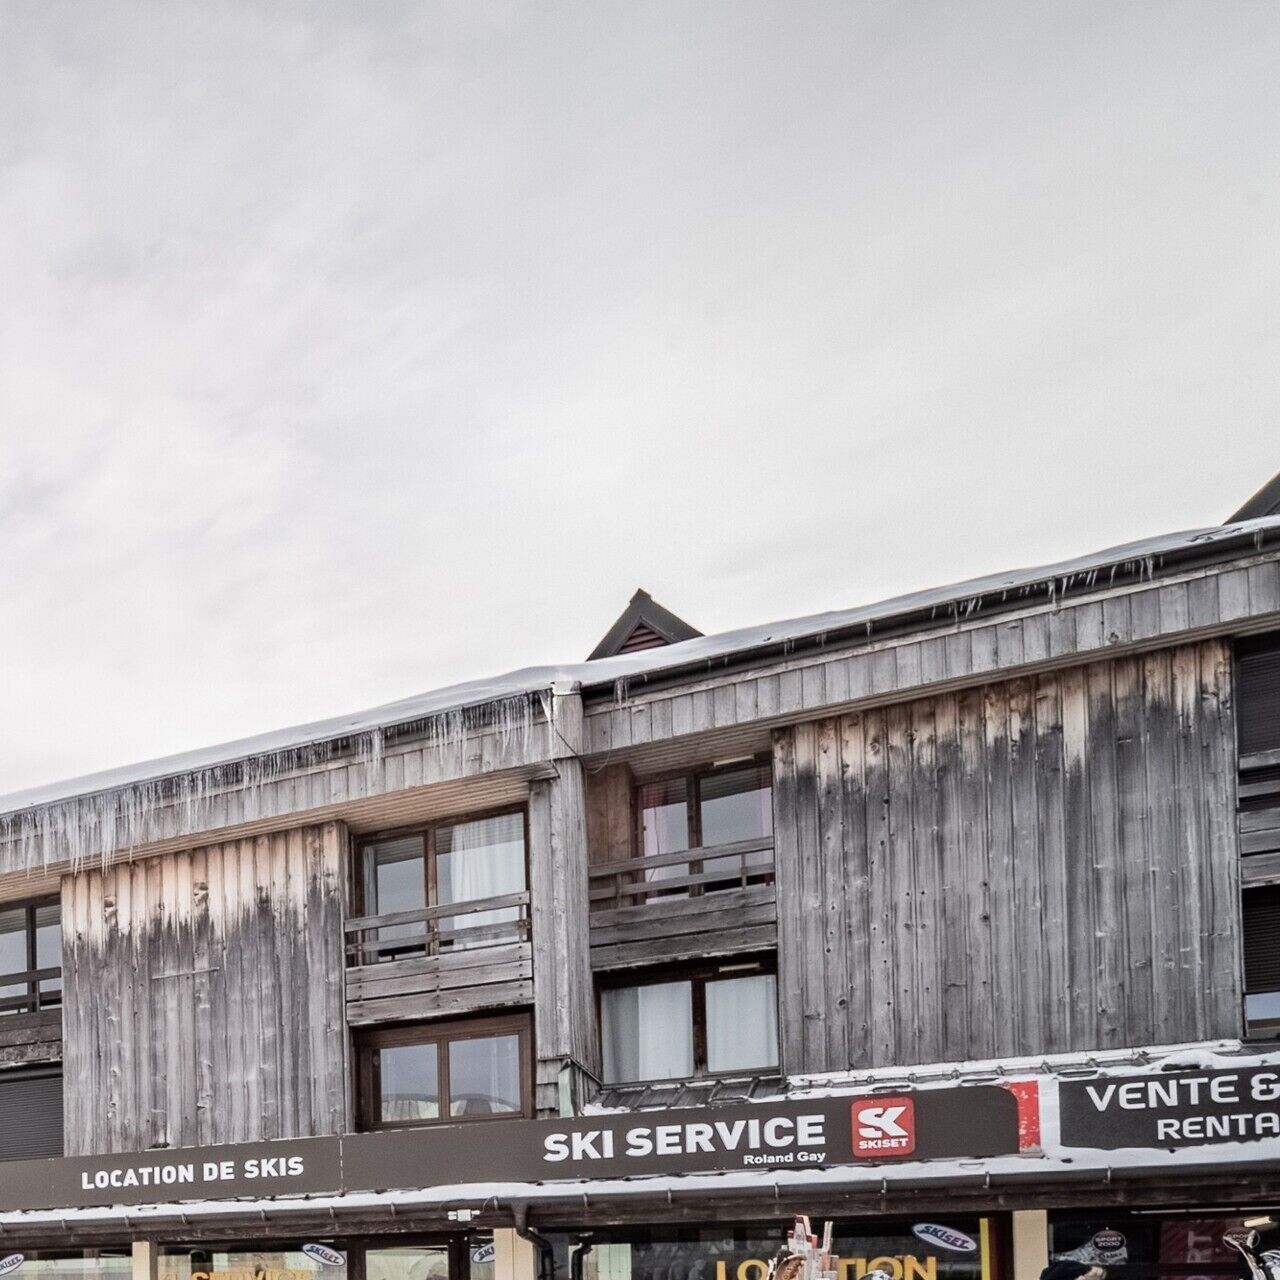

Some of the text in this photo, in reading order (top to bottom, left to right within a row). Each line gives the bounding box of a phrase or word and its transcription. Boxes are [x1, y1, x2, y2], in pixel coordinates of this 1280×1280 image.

[1085, 1073, 1280, 1112] VENTE &
[543, 1114, 826, 1162] SKI SERVICE
[1157, 1112, 1280, 1141] RENTA
[858, 1137, 909, 1150] SKISET
[743, 1151, 826, 1166] Roland Gay
[81, 1156, 304, 1190] LOCATION DE SKIS
[917, 1226, 971, 1250] SKISET
[306, 1245, 340, 1264] SKISET
